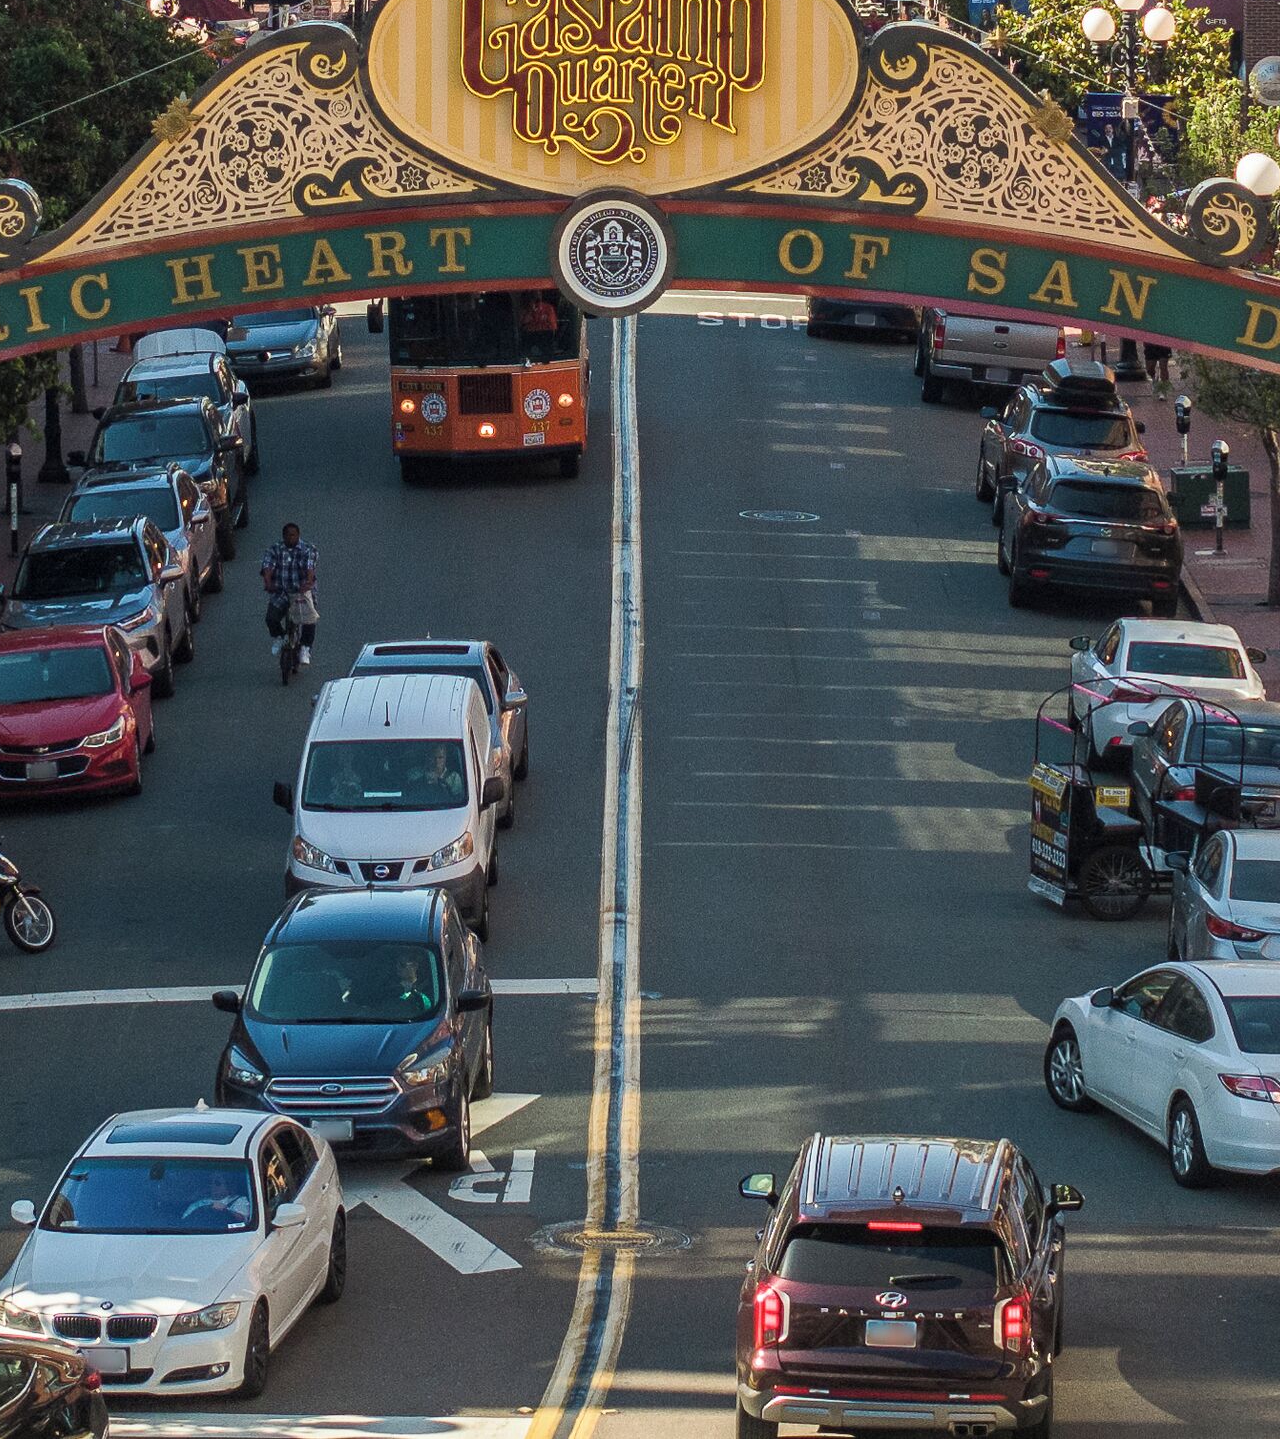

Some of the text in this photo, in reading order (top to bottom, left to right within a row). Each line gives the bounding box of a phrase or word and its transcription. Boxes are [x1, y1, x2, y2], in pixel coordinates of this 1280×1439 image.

[512, 55, 720, 165] Quarter
[165, 226, 471, 305] HEART
[778, 229, 891, 280] OF
[967, 247, 1158, 321] SAN
[697, 310, 808, 331] STOP
